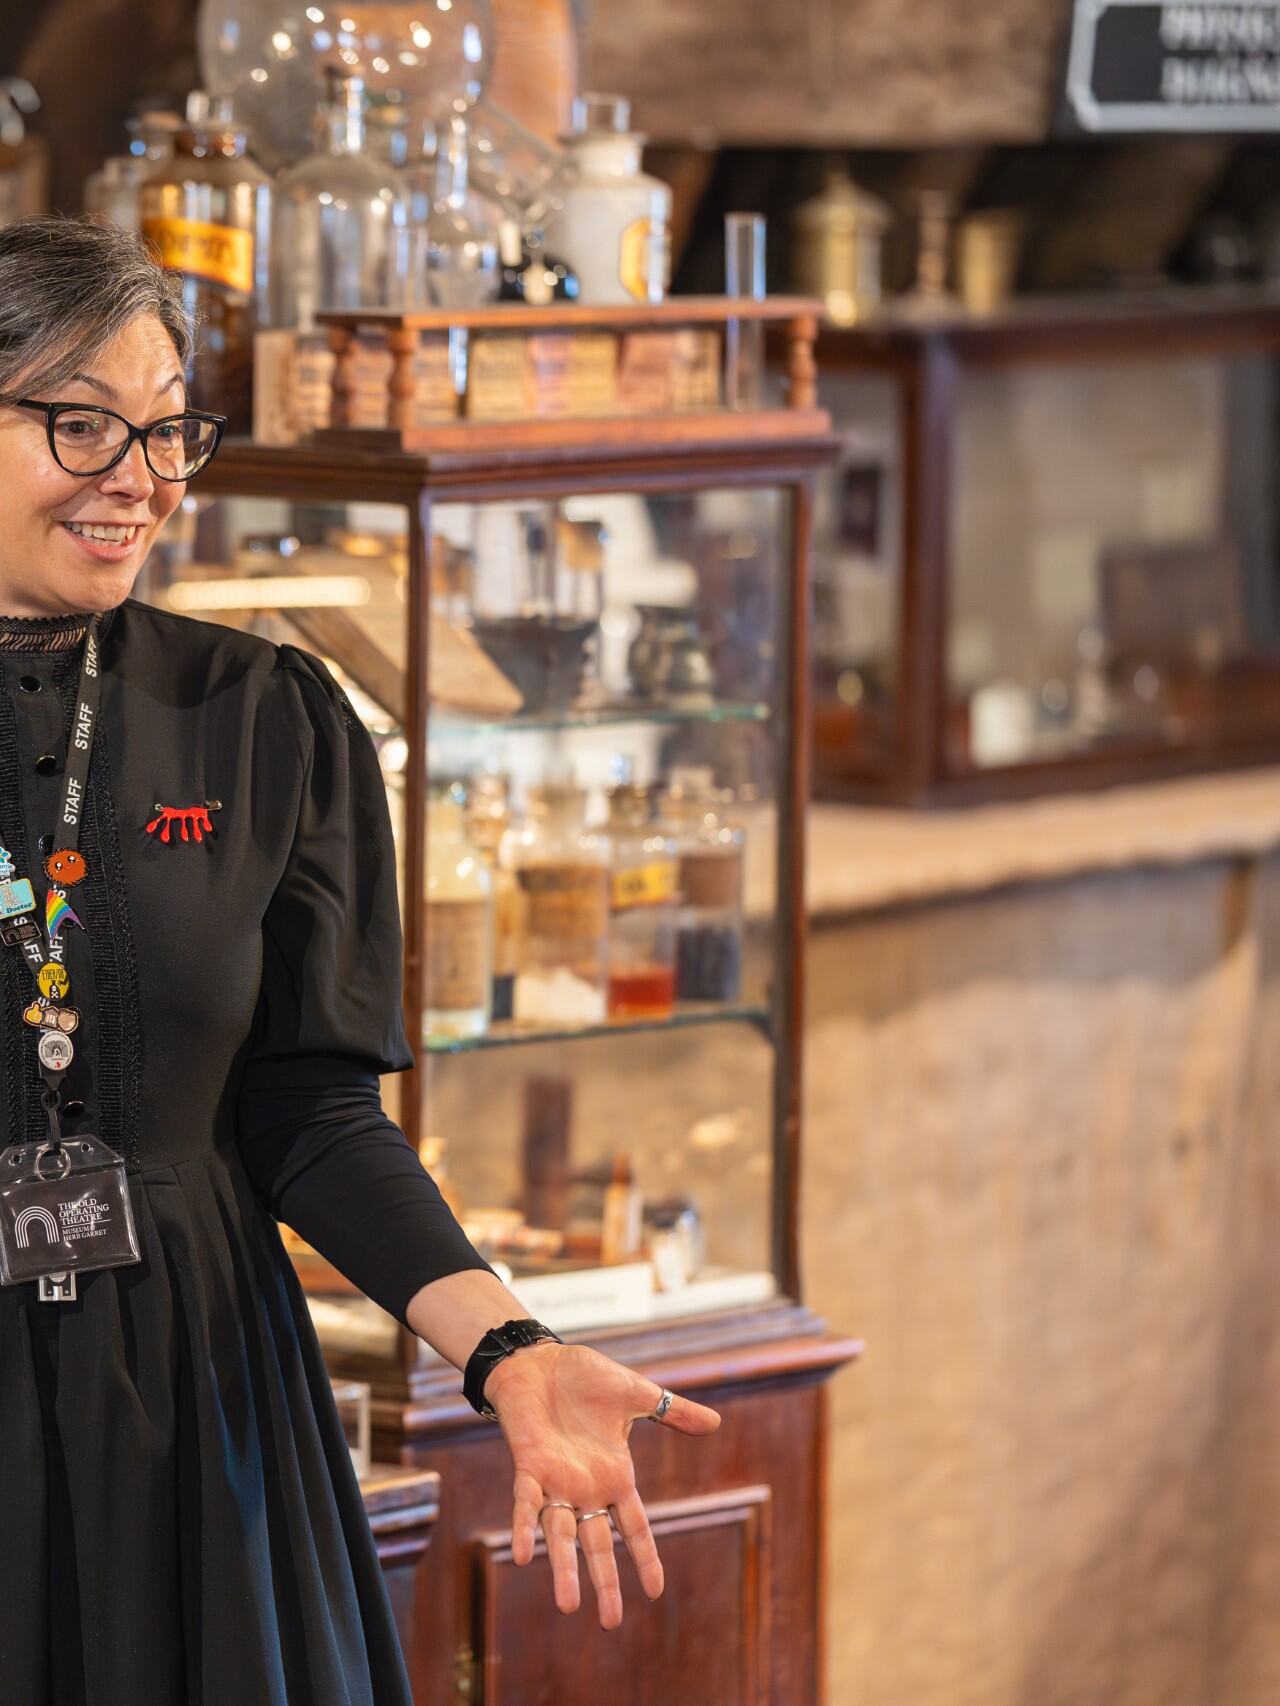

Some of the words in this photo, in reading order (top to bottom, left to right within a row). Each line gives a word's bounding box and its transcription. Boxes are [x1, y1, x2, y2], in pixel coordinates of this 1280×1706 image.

[85, 635, 97, 677] STAFF
[75, 703, 93, 750] STAFF
[63, 777, 82, 825] STAFF
[6, 902, 32, 914] Doctor
[57, 1202, 76, 1211] THE
[79, 1198, 97, 1207] OLD
[59, 1203, 109, 1217] OPERATING
[60, 1212, 102, 1225] THEATRE
[62, 1226, 89, 1234] MUSEUM
[63, 1233, 81, 1241] HERB
[81, 1230, 106, 1238] GARRET
